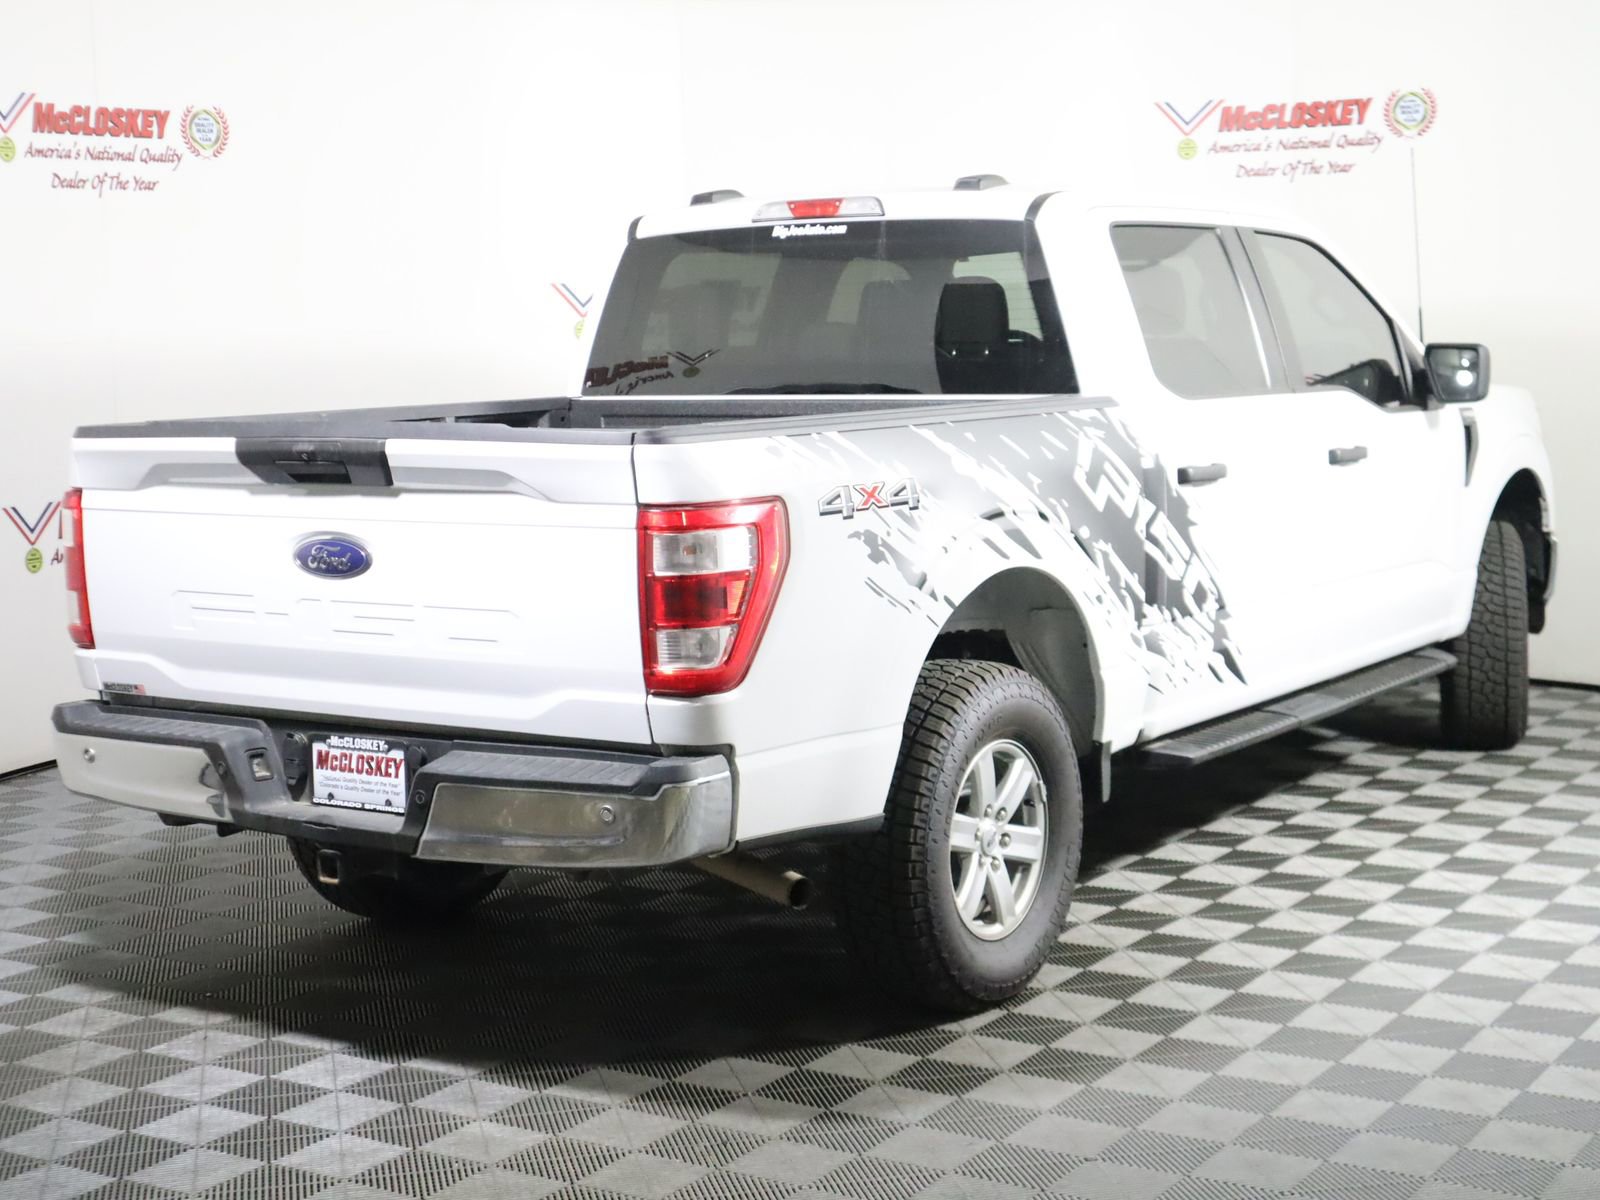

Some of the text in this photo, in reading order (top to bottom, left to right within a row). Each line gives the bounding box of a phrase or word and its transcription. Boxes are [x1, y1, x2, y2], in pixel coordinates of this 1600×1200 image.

[32, 101, 170, 139] McCLOSKEY
[1218, 97, 1373, 133] McCLOSKEY
[1207, 137, 1272, 155] America's
[1277, 132, 1334, 151] National
[1336, 130, 1383, 154] Quality
[24, 142, 81, 160] America's
[84, 143, 136, 162] National
[140, 146, 183, 171] Quality
[1236, 158, 1356, 183] Dealer Of The Year
[51, 171, 160, 198] Dealer Of The Year
[307, 543, 353, 571] Ford
[330, 735, 386, 751] McCLOSKEY
[315, 749, 405, 779] McCLOSKEY
[312, 798, 405, 813] COLORADO SPRINGS
